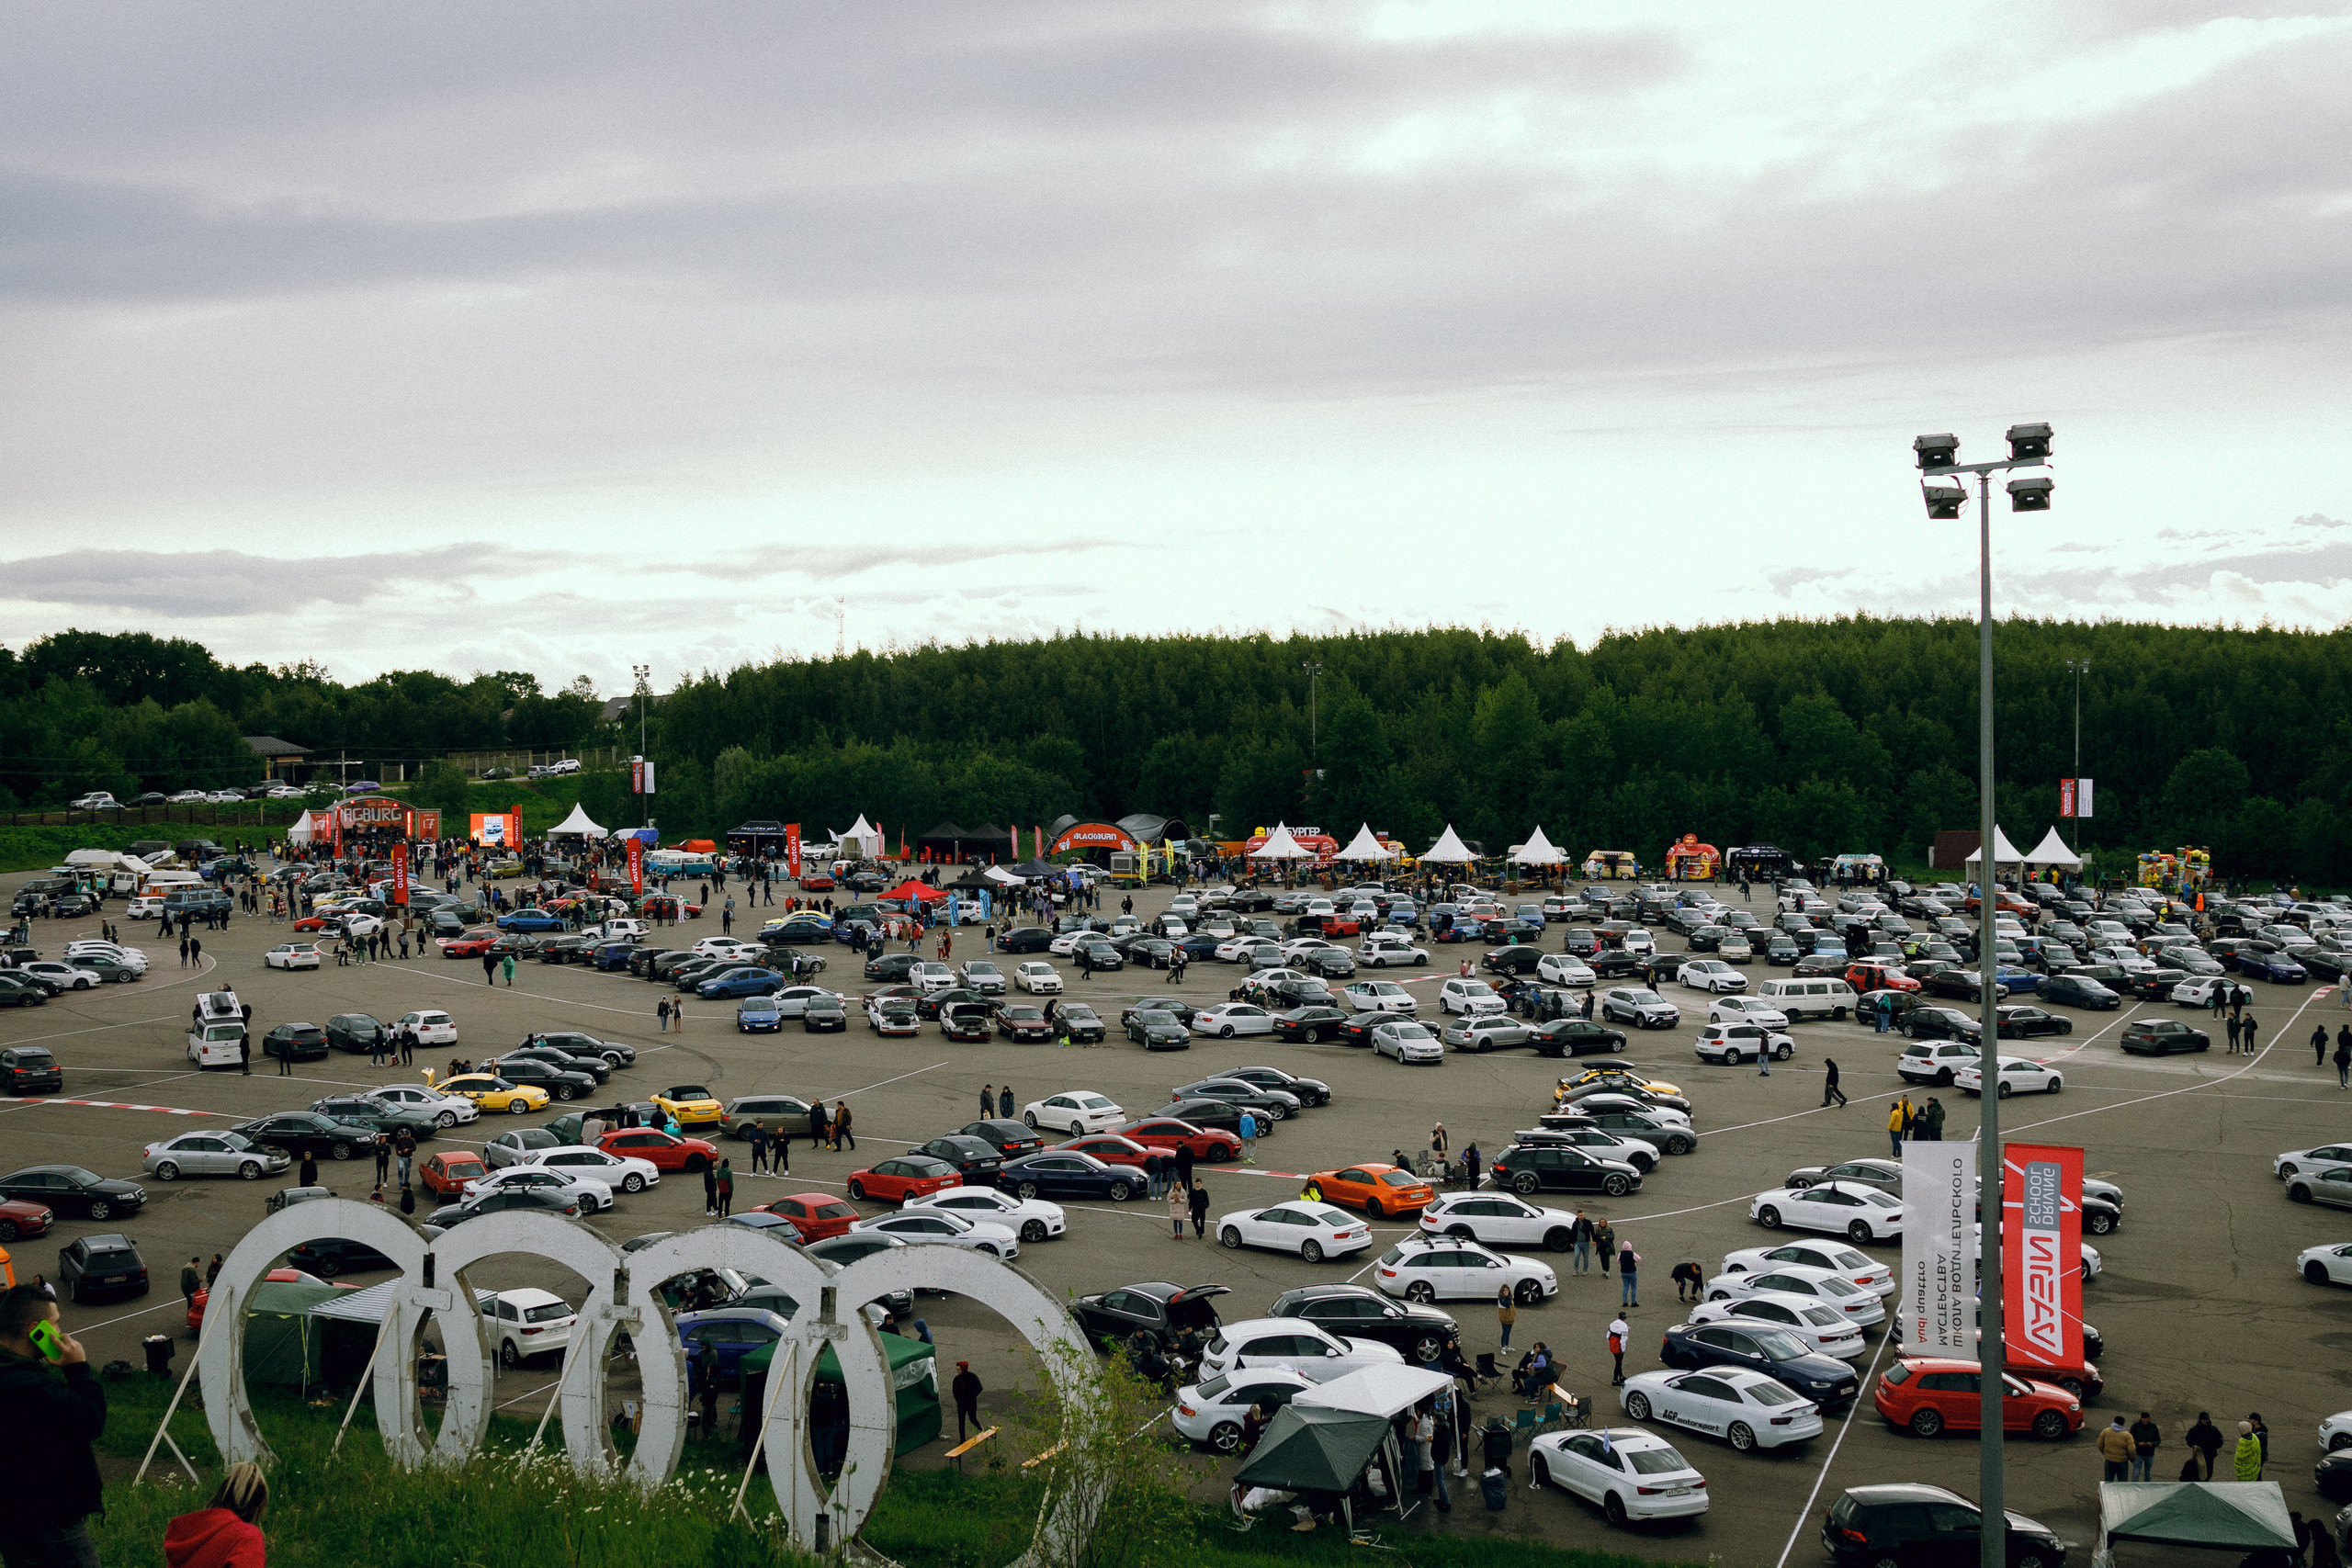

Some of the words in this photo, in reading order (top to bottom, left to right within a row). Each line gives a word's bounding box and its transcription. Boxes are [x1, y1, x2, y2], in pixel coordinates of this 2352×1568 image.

[1073, 832, 1117, 840] BLACKBURN
[1266, 827, 1320, 836] МБУРГЕР
[1662, 1408, 1679, 1423] AGP
[1678, 1418, 1720, 1431] motorsport
